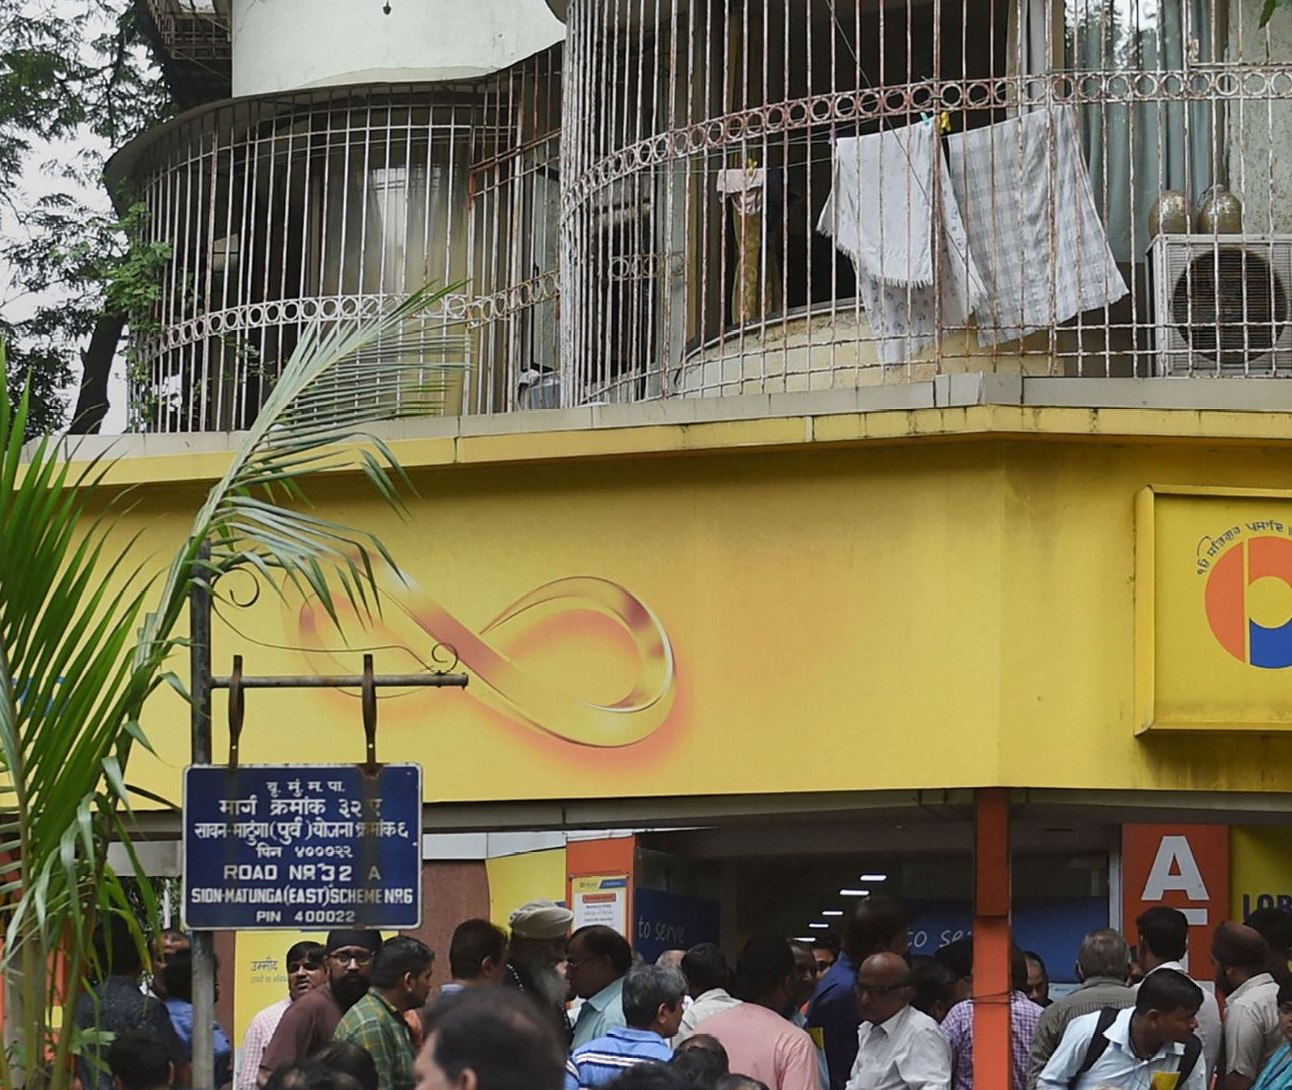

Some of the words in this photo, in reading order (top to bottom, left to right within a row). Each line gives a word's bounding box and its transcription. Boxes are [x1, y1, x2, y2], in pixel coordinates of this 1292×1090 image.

[270, 795, 326, 816] क्रमांक
[224, 865, 277, 880] ROAD
[368, 865, 381, 880] A
[256, 911, 281, 922] PIN
[294, 910, 356, 922] 400022
[637, 917, 651, 939] to
[654, 921, 685, 945] serve
